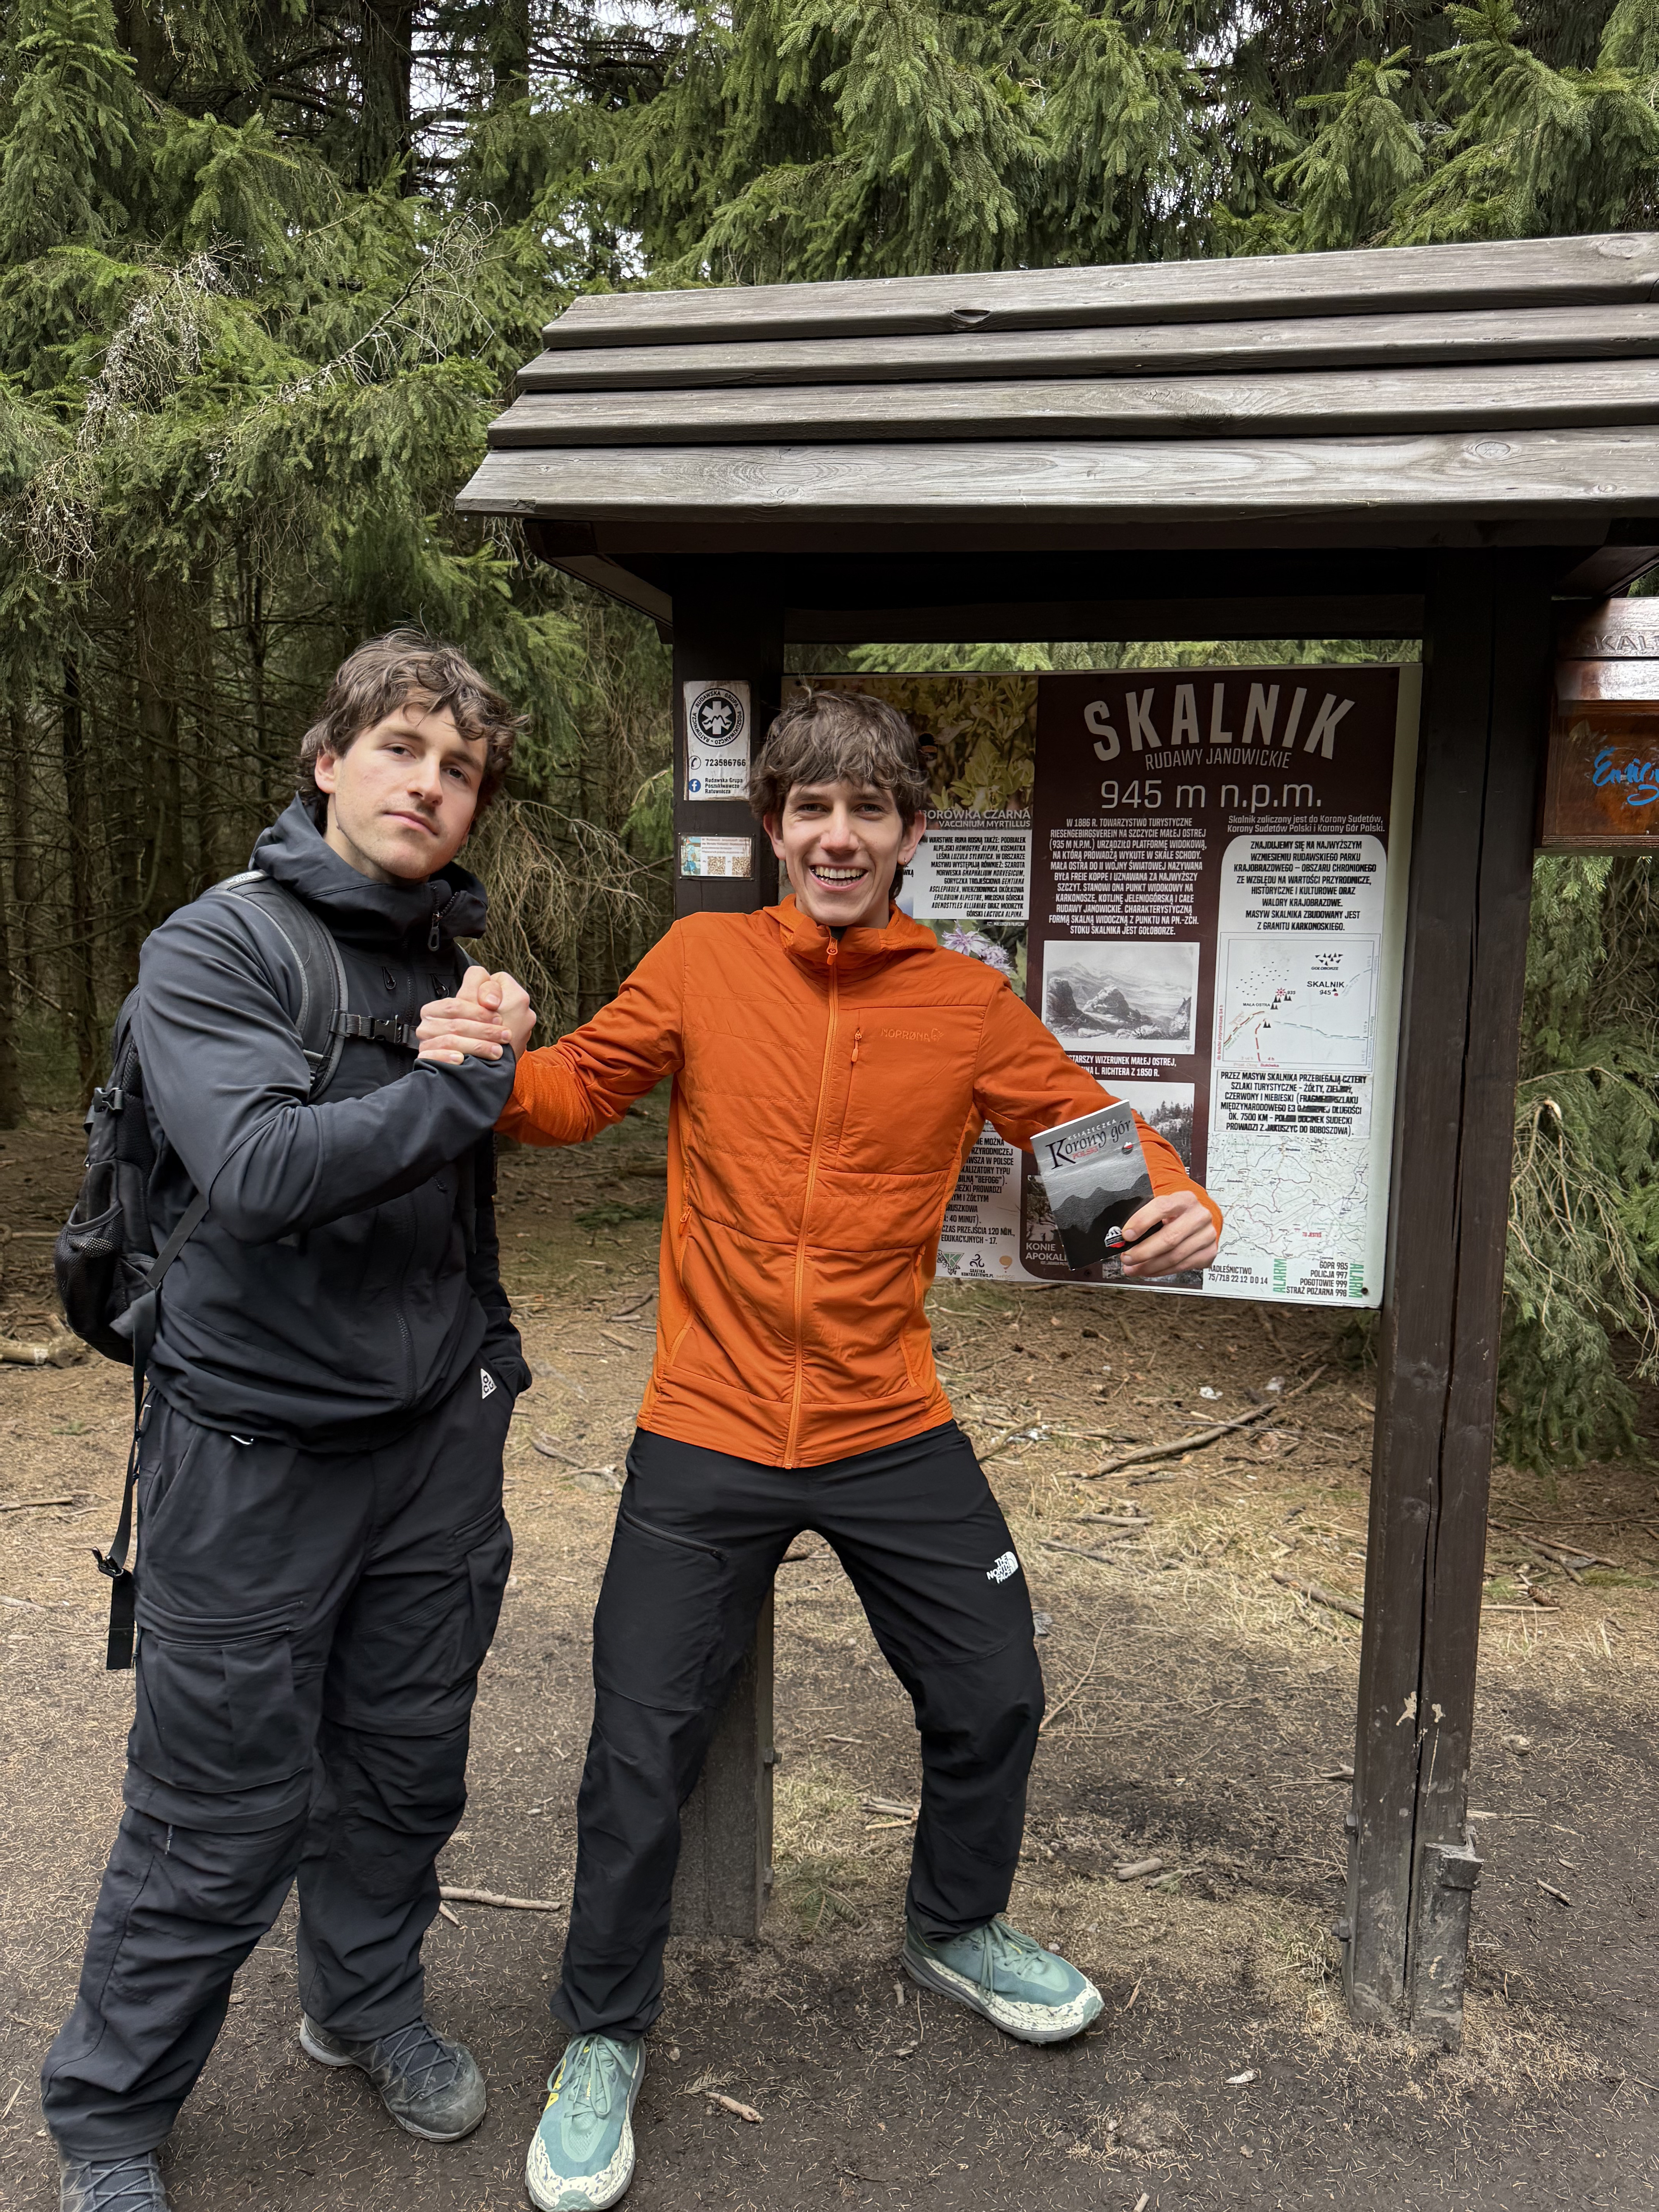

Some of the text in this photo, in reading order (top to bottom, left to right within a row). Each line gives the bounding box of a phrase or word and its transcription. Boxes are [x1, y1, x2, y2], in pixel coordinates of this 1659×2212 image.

[692, 690, 738, 743] RUDAWSKA GRUPA RATOWNICZA
[1084, 683, 1355, 761] SKALNIK
[1146, 748, 1292, 770] RUDAWY JANOWICKIE
[1101, 780, 1321, 813] 945 m n.p.m.
[983, 810, 1030, 819] CZARNA
[1257, 815, 1291, 824] zaliczony
[1293, 816, 1307, 824] jest
[1320, 816, 1346, 824] Korony
[1348, 815, 1383, 823] Sudetów,
[1149, 818, 1192, 826] TURYSTYCZNE
[1255, 824, 1287, 833] Sudetów
[1289, 824, 1312, 832] Polski
[1317, 824, 1343, 833] Korony
[1346, 823, 1358, 831] Gór
[1051, 830, 1117, 838] RIESENGEBIRGSVEREIN
[1160, 829, 1180, 837] MAŁEJ
[1182, 829, 1206, 837] OSTREJ
[1097, 840, 1207, 850] URZĄDZIŁO PLATFORMĘ WIDOKOWĄ,
[1294, 842, 1305, 851] SIĘ
[1317, 840, 1362, 849] NAJWYŻSZYM
[1062, 850, 1082, 861] KTÓRĄ
[1129, 860, 1166, 870] ŚWIATOWEJ
[1168, 862, 1202, 870] NAZYWANA
[1159, 871, 1197, 881] NAJWYŻSZY
[1246, 876, 1276, 886] WZGLĘDU
[1288, 874, 1320, 884] WARTOŚCI
[1322, 876, 1371, 885] PRZYRODNICZE,
[1056, 894, 1097, 903] KARKONOSZE,
[1098, 894, 1123, 904] KOTLINĘ
[1125, 892, 1173, 904] JELENIOGÓRSKĄ
[1125, 905, 1192, 915] CHARAKTERYSTYCZNĄ
[1049, 915, 1070, 925] FORMĄ
[1071, 915, 1094, 926] SKALNĄ
[1096, 916, 1128, 926] WIDOCZNĄ
[1091, 926, 1120, 934] SKALNIKA
[1291, 922, 1345, 931] KARKONOSKIEGO.
[1095, 1056, 1176, 1067] WIZERUNEK MAŁEJ OSTREJ,
[1101, 1067, 1130, 1075] RICHTERA
[1267, 1073, 1297, 1081] SKALNIKA
[1299, 1074, 1341, 1084] PRZEBIEGAJĄ
[1254, 1083, 1297, 1091] TURYSTYCZNE
[1221, 1103, 1362, 1114] MIĘDZYNARODOWEGO DŁUGOŚCI
[1045, 1120, 1130, 1170] Korony gór
[957, 1226, 986, 1234] PRZEJŚCIA
[941, 1235, 983, 1243] EDUKACYJNYCH
[1026, 1243, 1056, 1251] KONIE
[1273, 1259, 1286, 1293] ALARM
[1311, 1270, 1334, 1278] POLICJA
[1300, 1278, 1334, 1287] POGOTOWIE
[1349, 1263, 1364, 1298] ALARM
[1307, 1287, 1333, 1295] POŻARNA
[994, 1553, 1007, 1567] THE
[987, 1561, 1010, 1580] NORTH
[996, 1567, 1012, 1584] FACE
